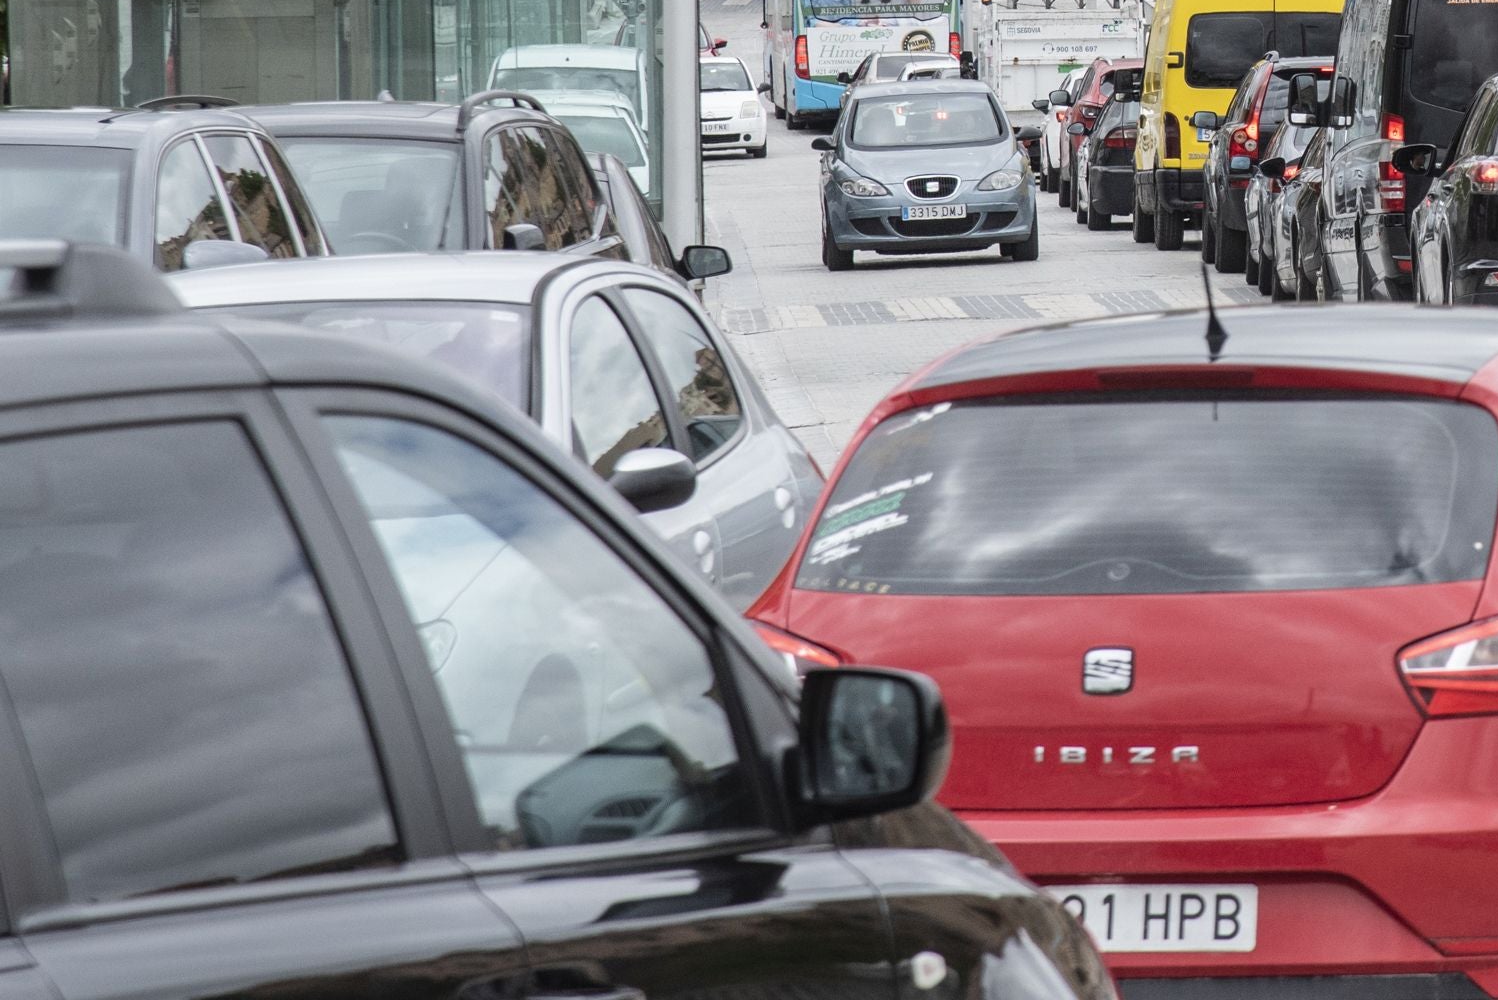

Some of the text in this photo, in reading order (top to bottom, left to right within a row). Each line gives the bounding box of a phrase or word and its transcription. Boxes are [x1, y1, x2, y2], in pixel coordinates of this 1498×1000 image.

[820, 4, 940, 16] RESIDENCIA PARA MAYORES
[1102, 24, 1119, 32] FCC
[819, 31, 857, 44] Grupo
[910, 206, 964, 218] 3315 DMJ
[1034, 746, 1199, 764] IBIZA
[1062, 893, 1242, 940] 91 HPB
